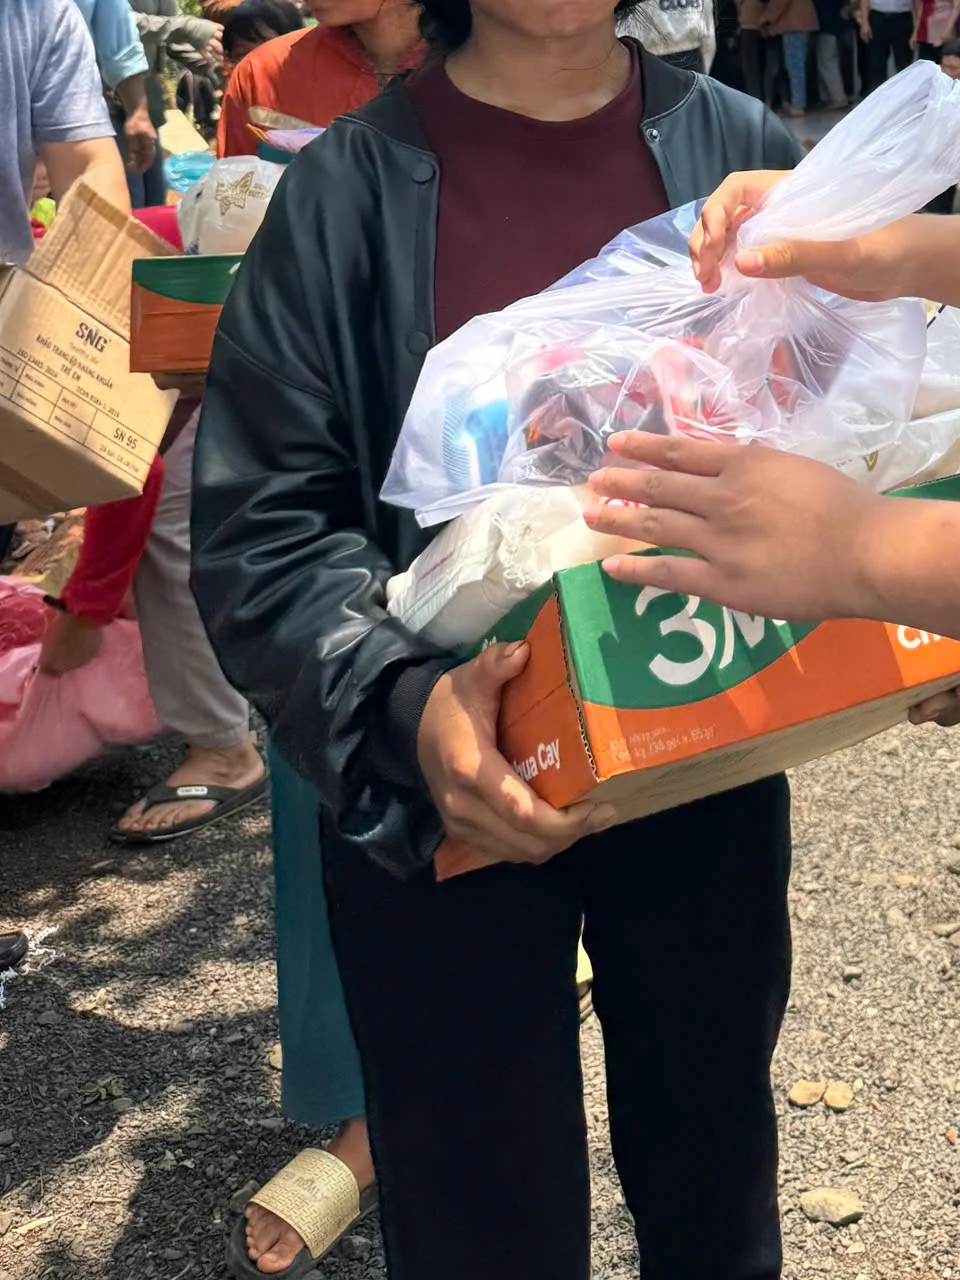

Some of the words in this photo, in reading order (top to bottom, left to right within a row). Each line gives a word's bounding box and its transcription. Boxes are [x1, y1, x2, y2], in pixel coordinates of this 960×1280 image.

[75, 322, 107, 352] SNG
[113, 427, 126, 443] SN
[126, 435, 138, 450] 95
[513, 756, 539, 781] hua
[537, 738, 560, 770] Cay
